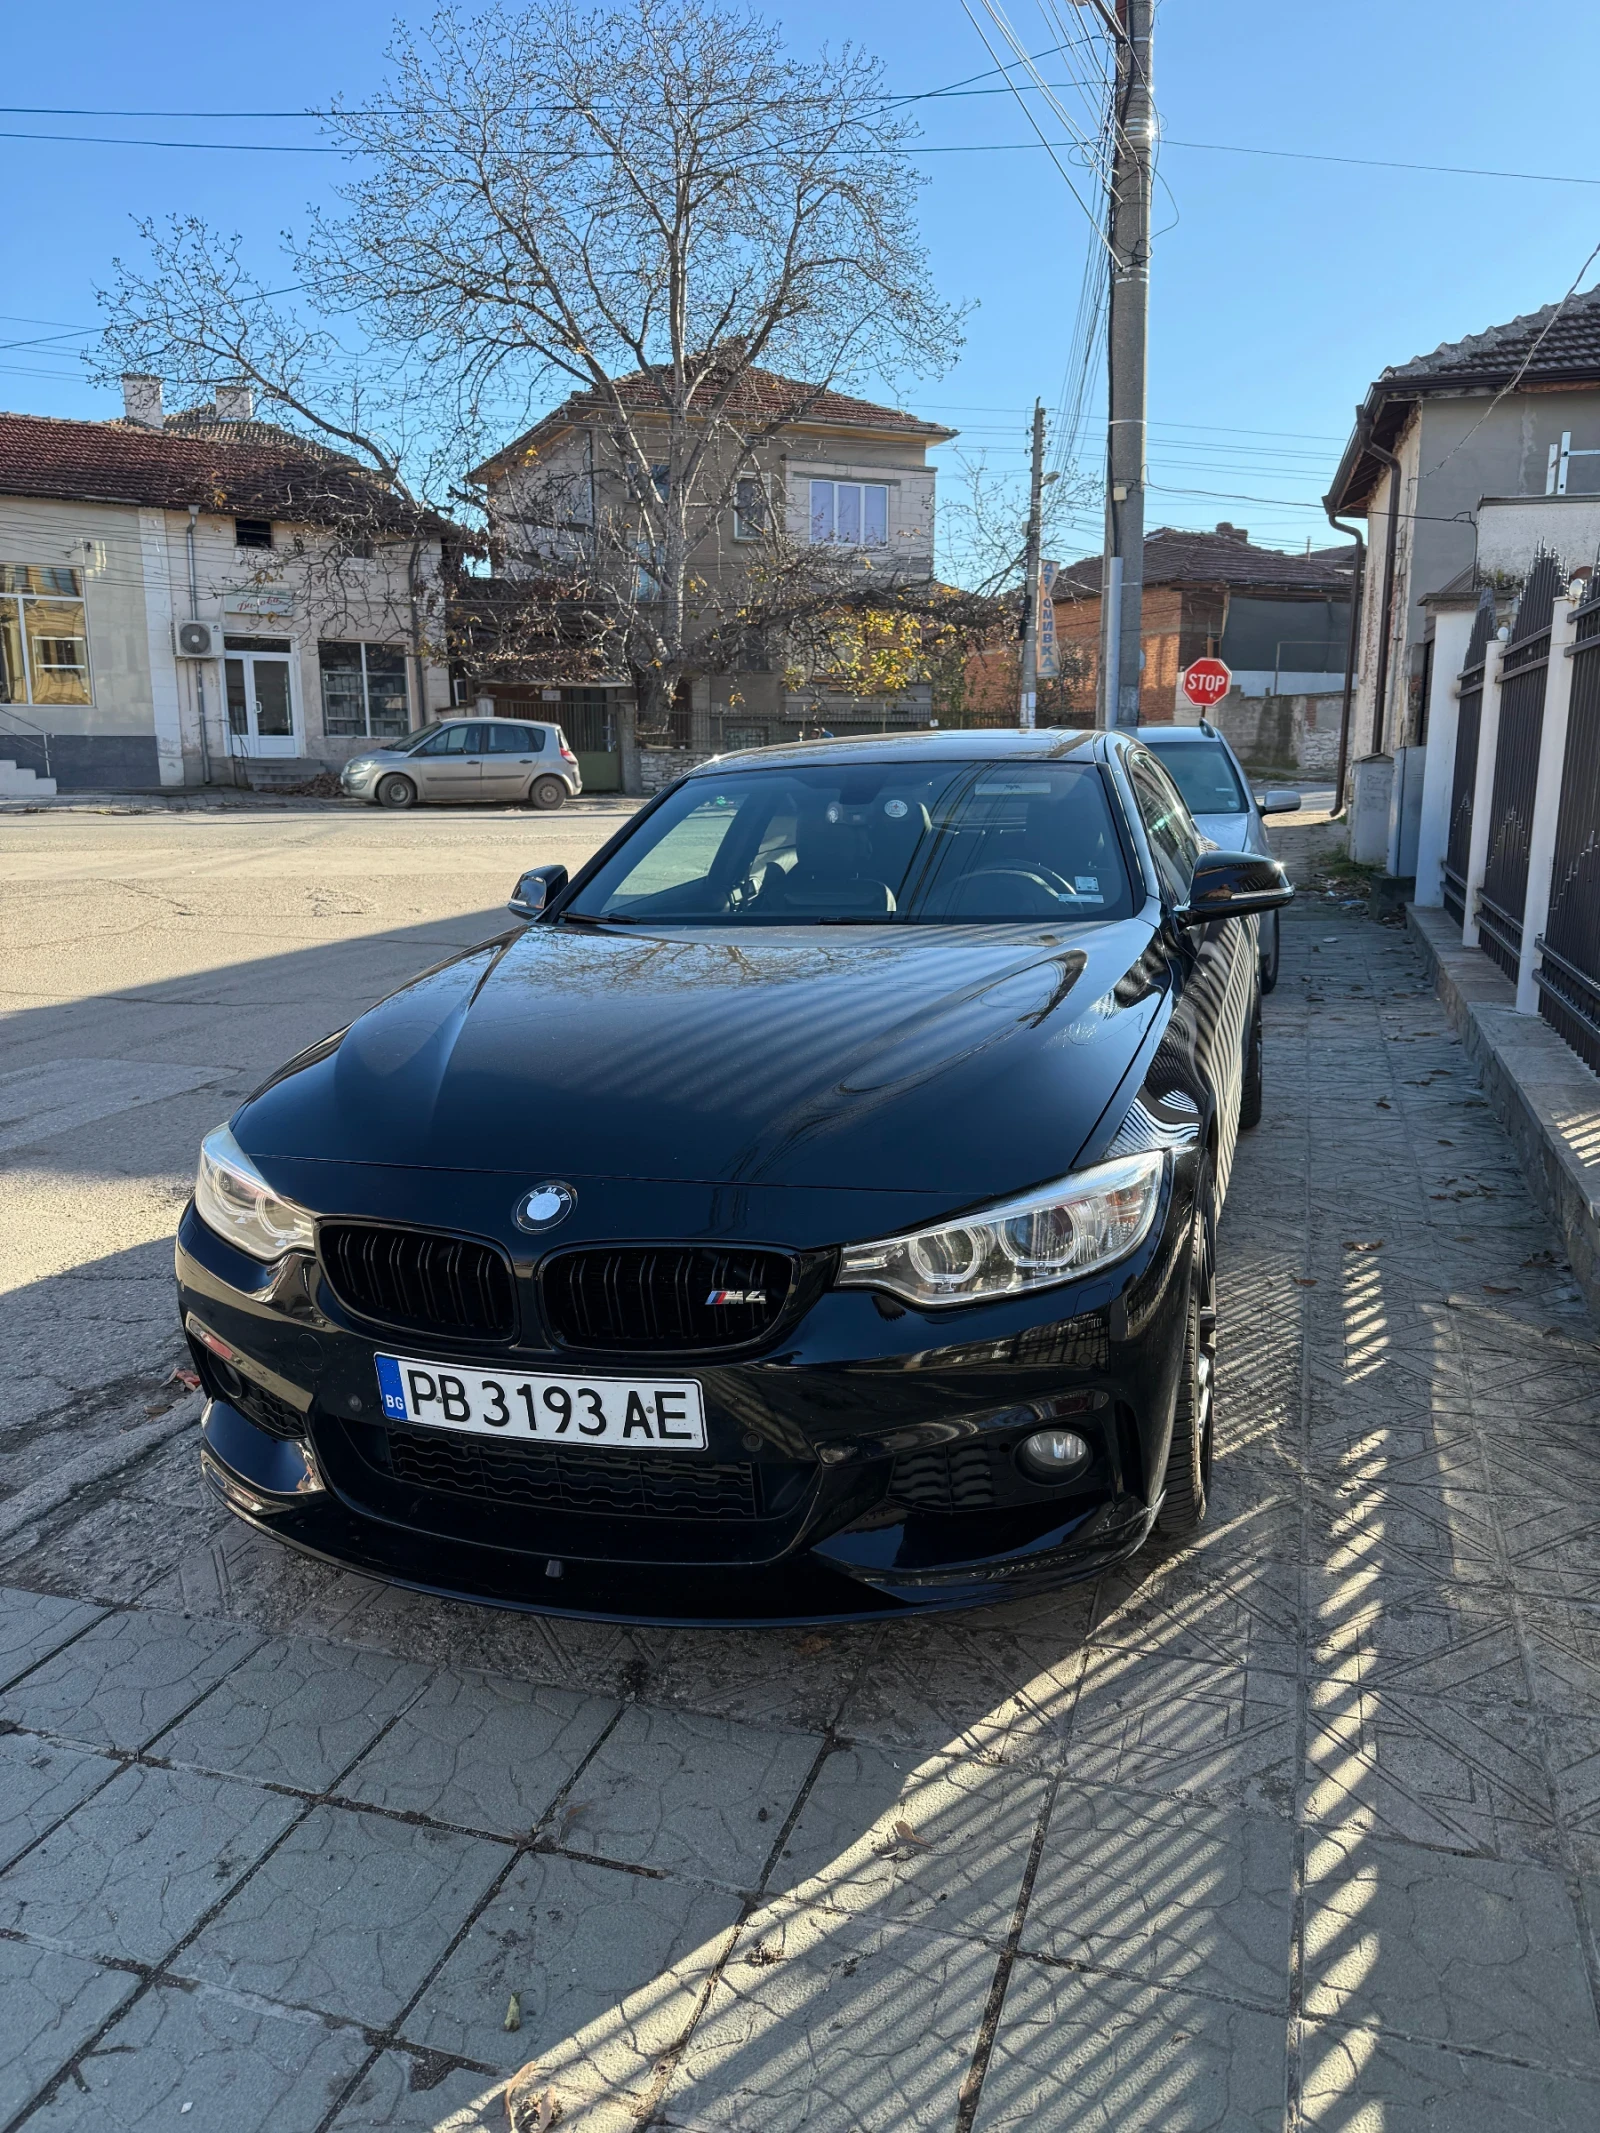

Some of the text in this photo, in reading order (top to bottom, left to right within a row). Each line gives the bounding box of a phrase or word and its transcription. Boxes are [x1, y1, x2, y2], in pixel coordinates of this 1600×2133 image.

[1187, 673, 1226, 692] STOP
[529, 1187, 570, 1202] BMW
[721, 1290, 767, 1305] M4
[385, 1394, 404, 1411] BG
[407, 1369, 693, 1440] PB 3193 AE
